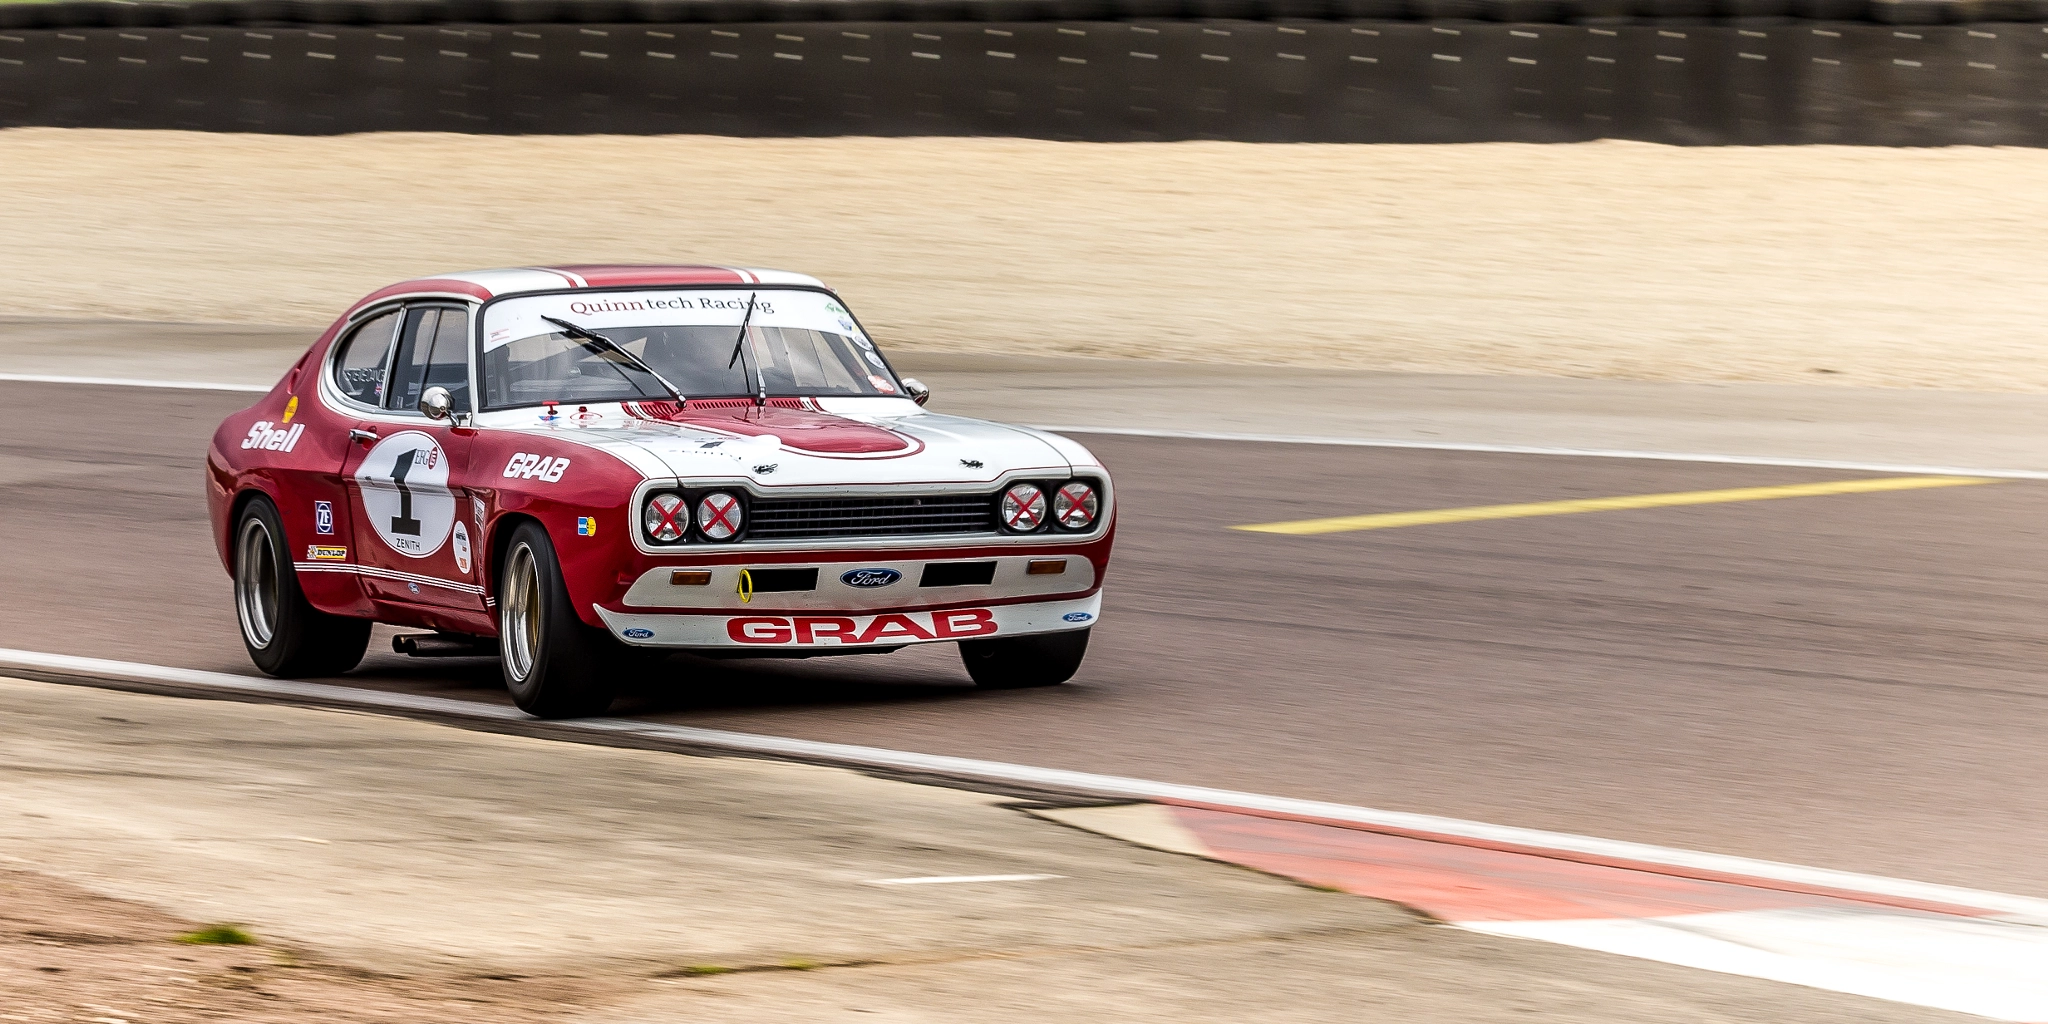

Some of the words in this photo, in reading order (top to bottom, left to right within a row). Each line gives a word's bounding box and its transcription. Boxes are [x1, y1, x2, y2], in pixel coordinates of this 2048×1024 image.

[698, 297, 775, 315] Racing
[240, 420, 306, 453] Shell
[502, 452, 571, 483] GRAB
[389, 448, 421, 537] 1
[316, 548, 346, 557] DUNLOP
[396, 537, 421, 552] ZENITH
[850, 570, 892, 586] Ford
[726, 608, 999, 645] GRAB
